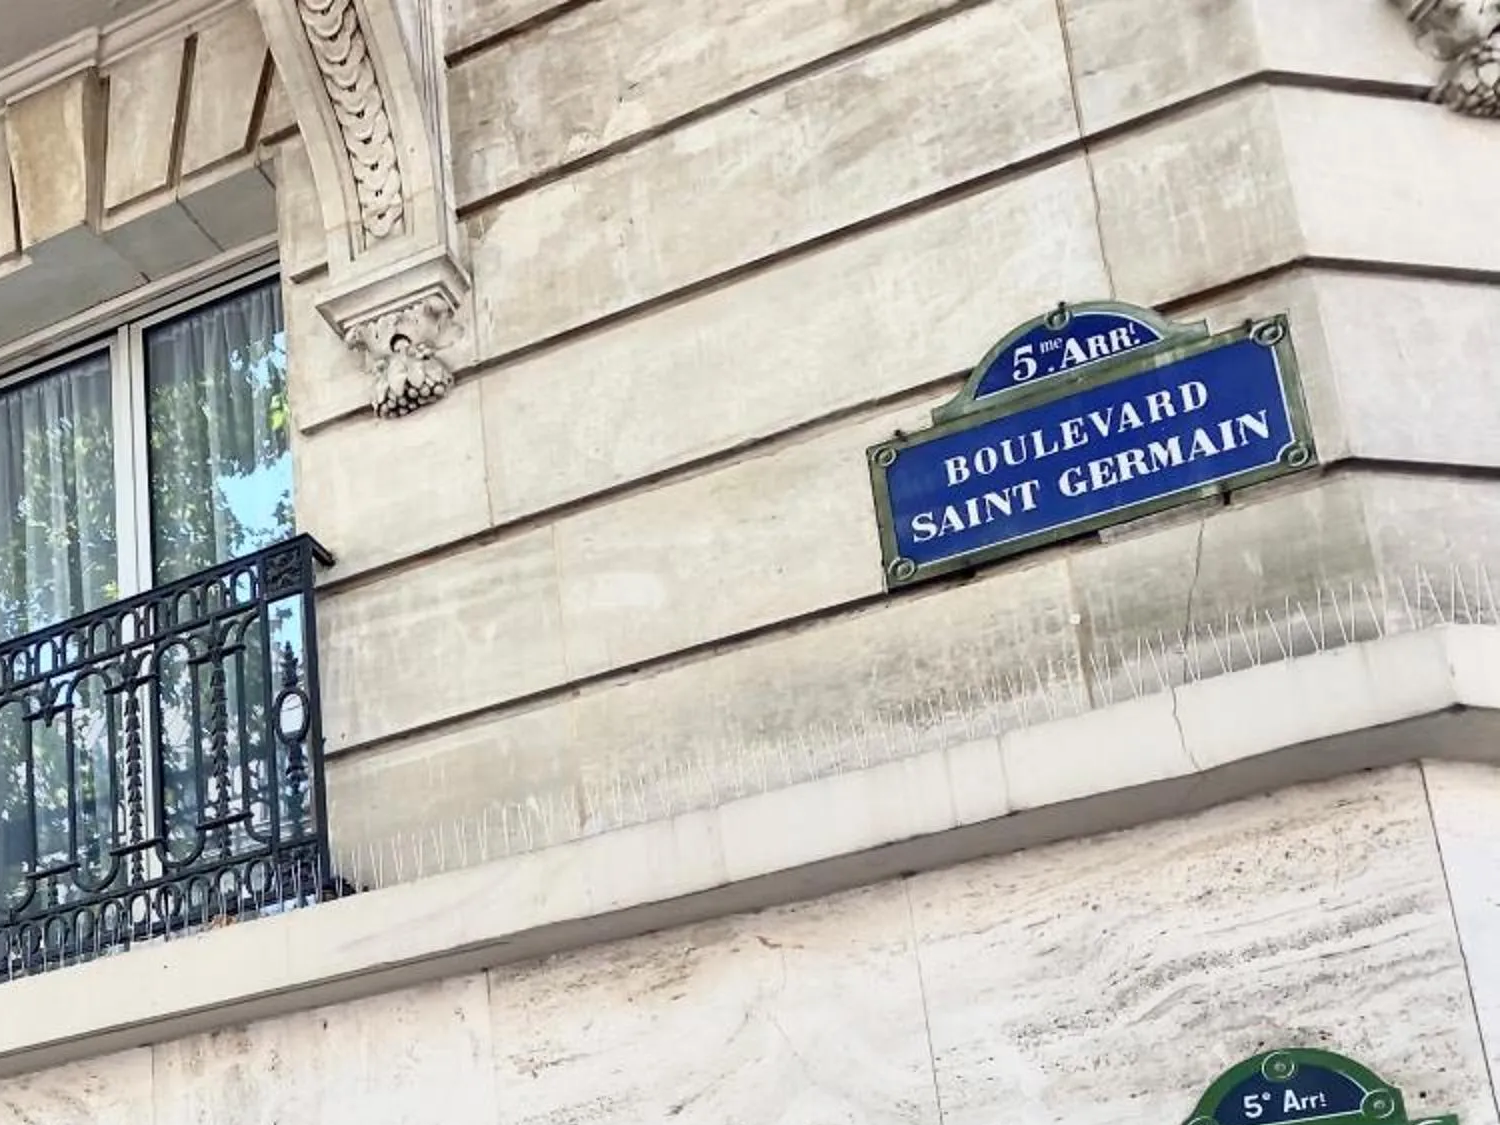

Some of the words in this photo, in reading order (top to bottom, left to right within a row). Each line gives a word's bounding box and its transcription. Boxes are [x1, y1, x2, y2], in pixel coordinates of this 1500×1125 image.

[911, 479, 1040, 543] SAINT
[1058, 409, 1270, 498] GERMAIN
[944, 381, 1208, 486] BOULEVARD
